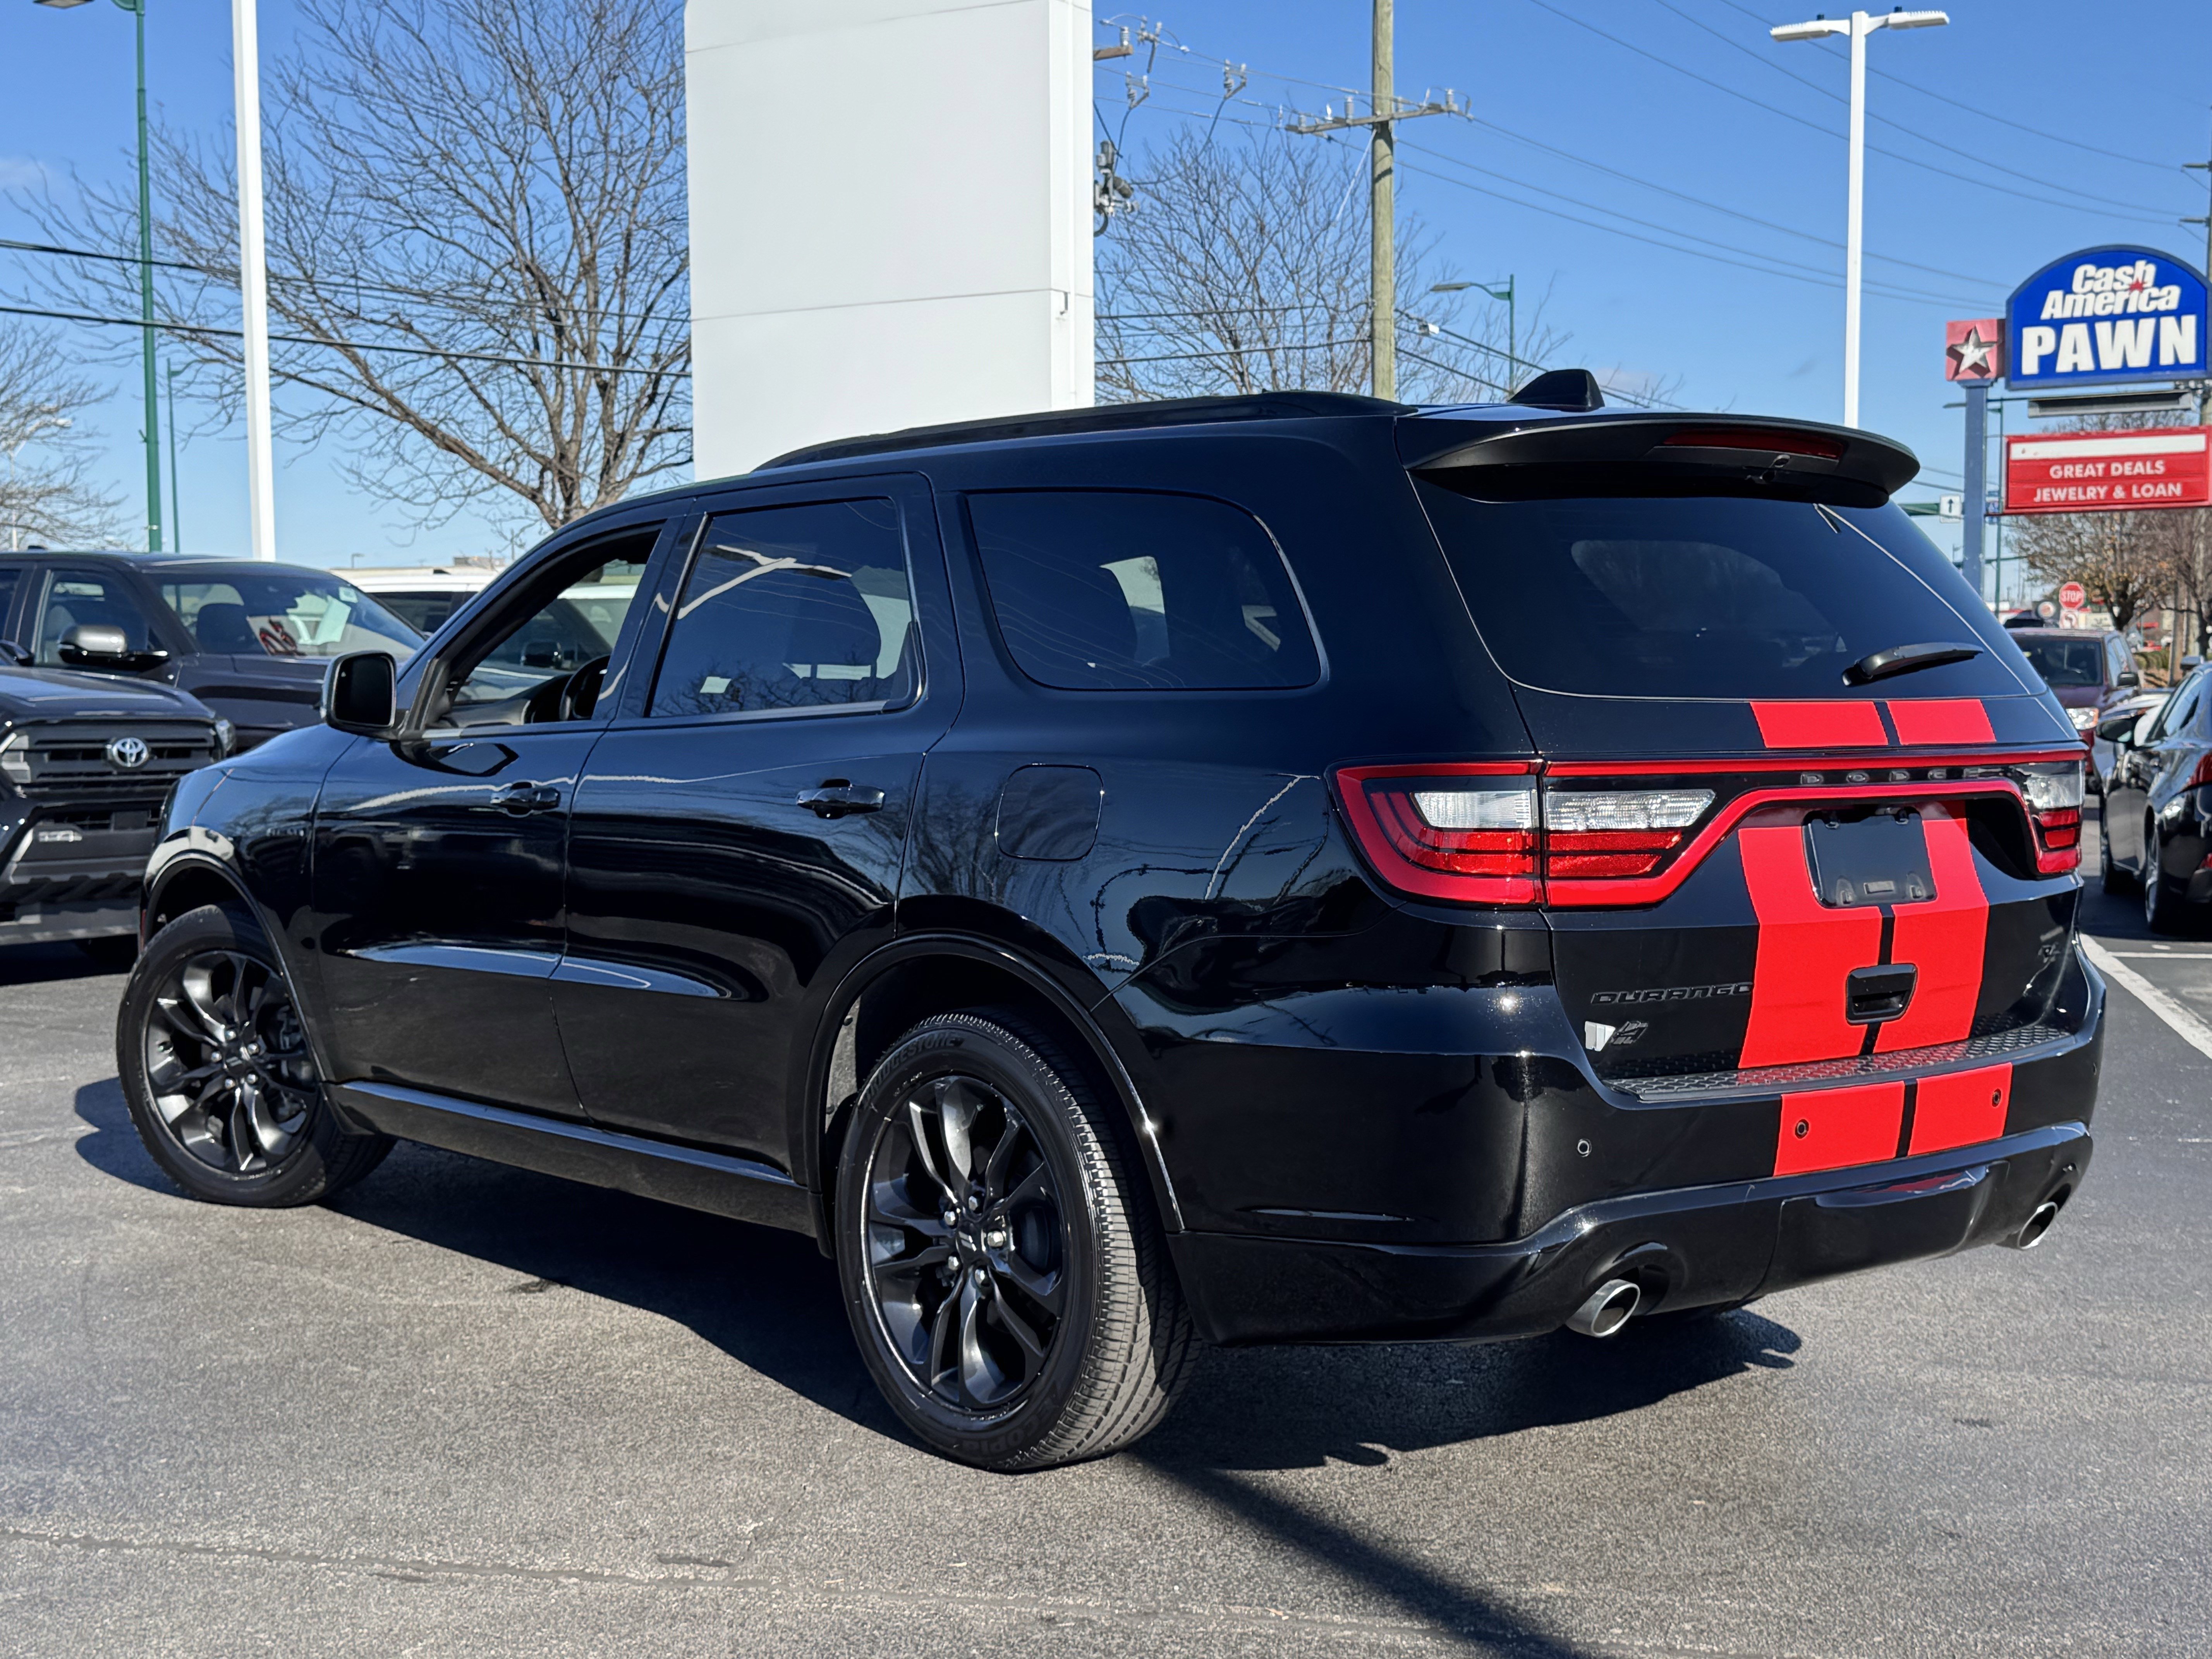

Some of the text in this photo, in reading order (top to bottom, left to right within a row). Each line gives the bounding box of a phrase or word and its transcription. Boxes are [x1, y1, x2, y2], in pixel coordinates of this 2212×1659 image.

[2072, 260, 2156, 293] Cash
[2040, 285, 2181, 319] America
[2022, 315, 2197, 375] PAWN
[2049, 460, 2166, 480] GREAT DEALS
[2034, 483, 2182, 503] JEWELRY & LOAN
[2061, 590, 2082, 602] STOP
[1590, 982, 1753, 1004] DURANGO
[864, 1031, 957, 1110] BRIDGESTONE
